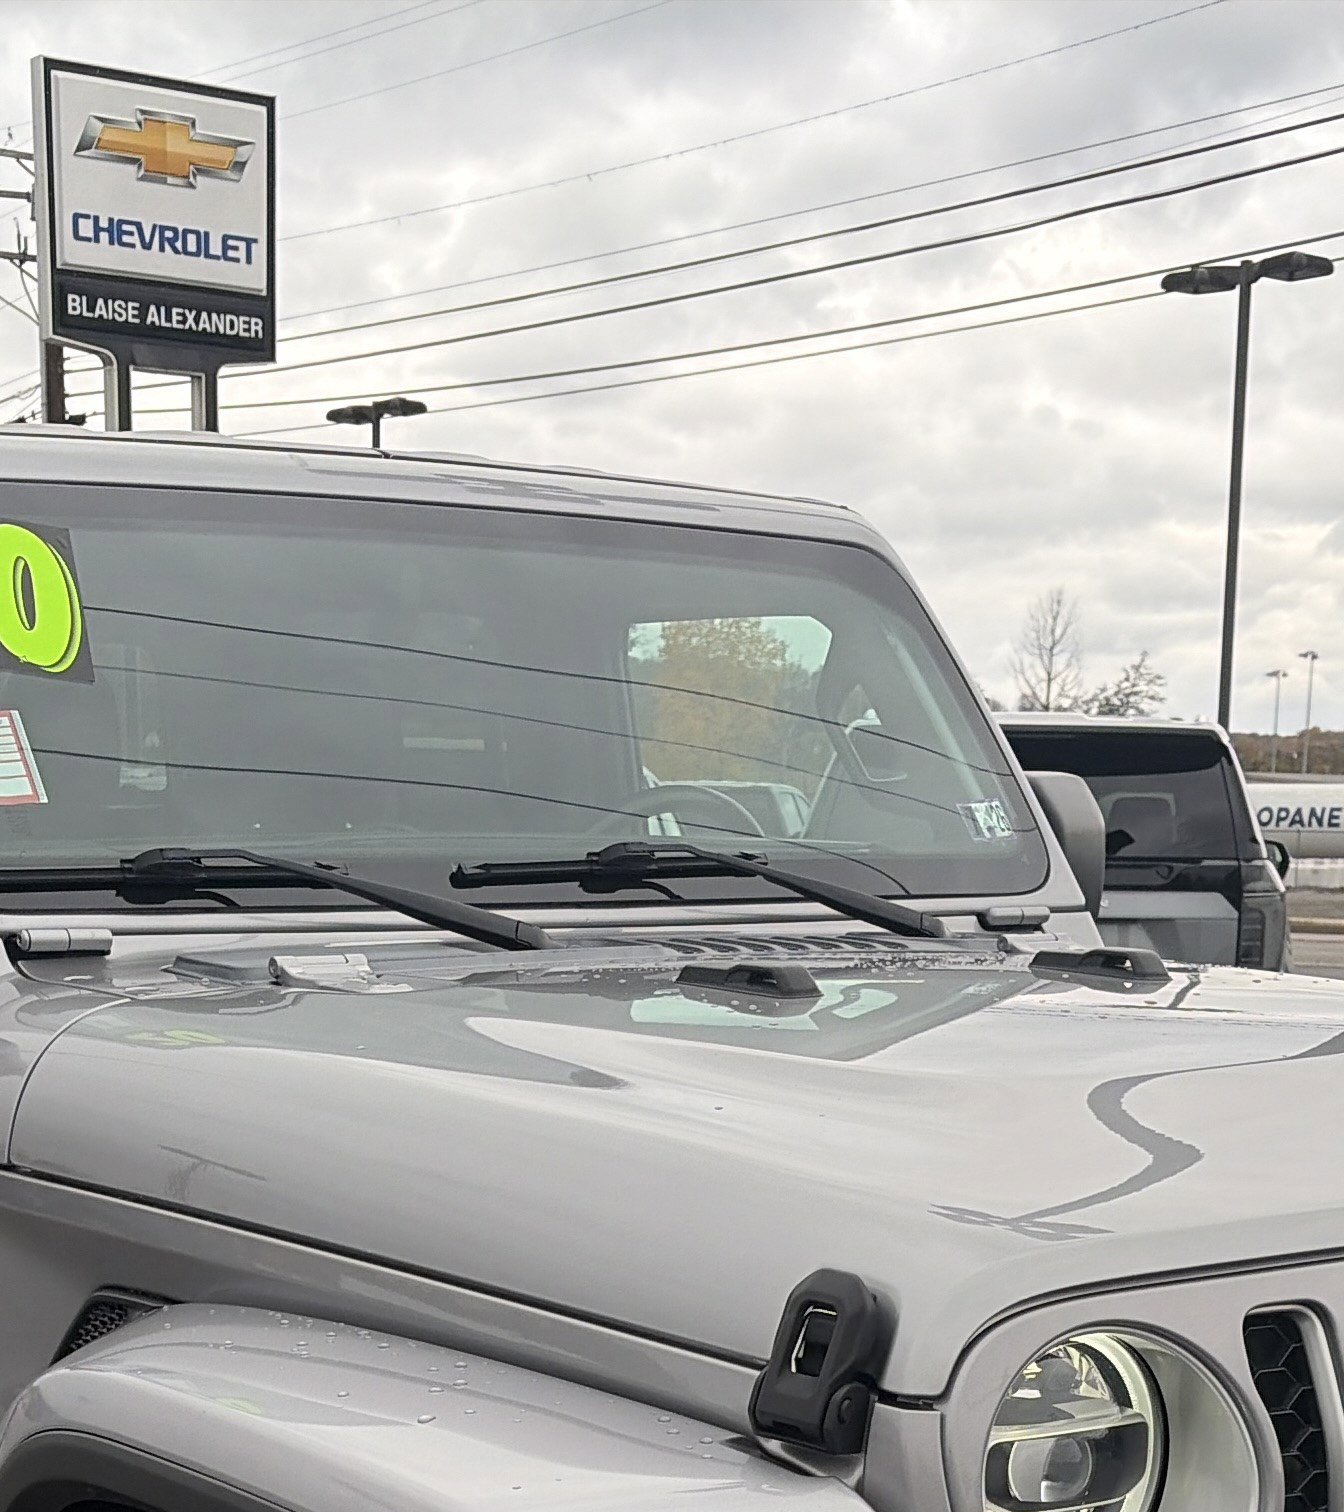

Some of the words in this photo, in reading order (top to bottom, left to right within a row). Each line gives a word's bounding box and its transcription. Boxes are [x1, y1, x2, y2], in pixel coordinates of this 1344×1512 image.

[71, 211, 258, 265] CHEVROLET
[66, 293, 140, 325] BLAISE
[145, 304, 264, 340] ALEXANDER
